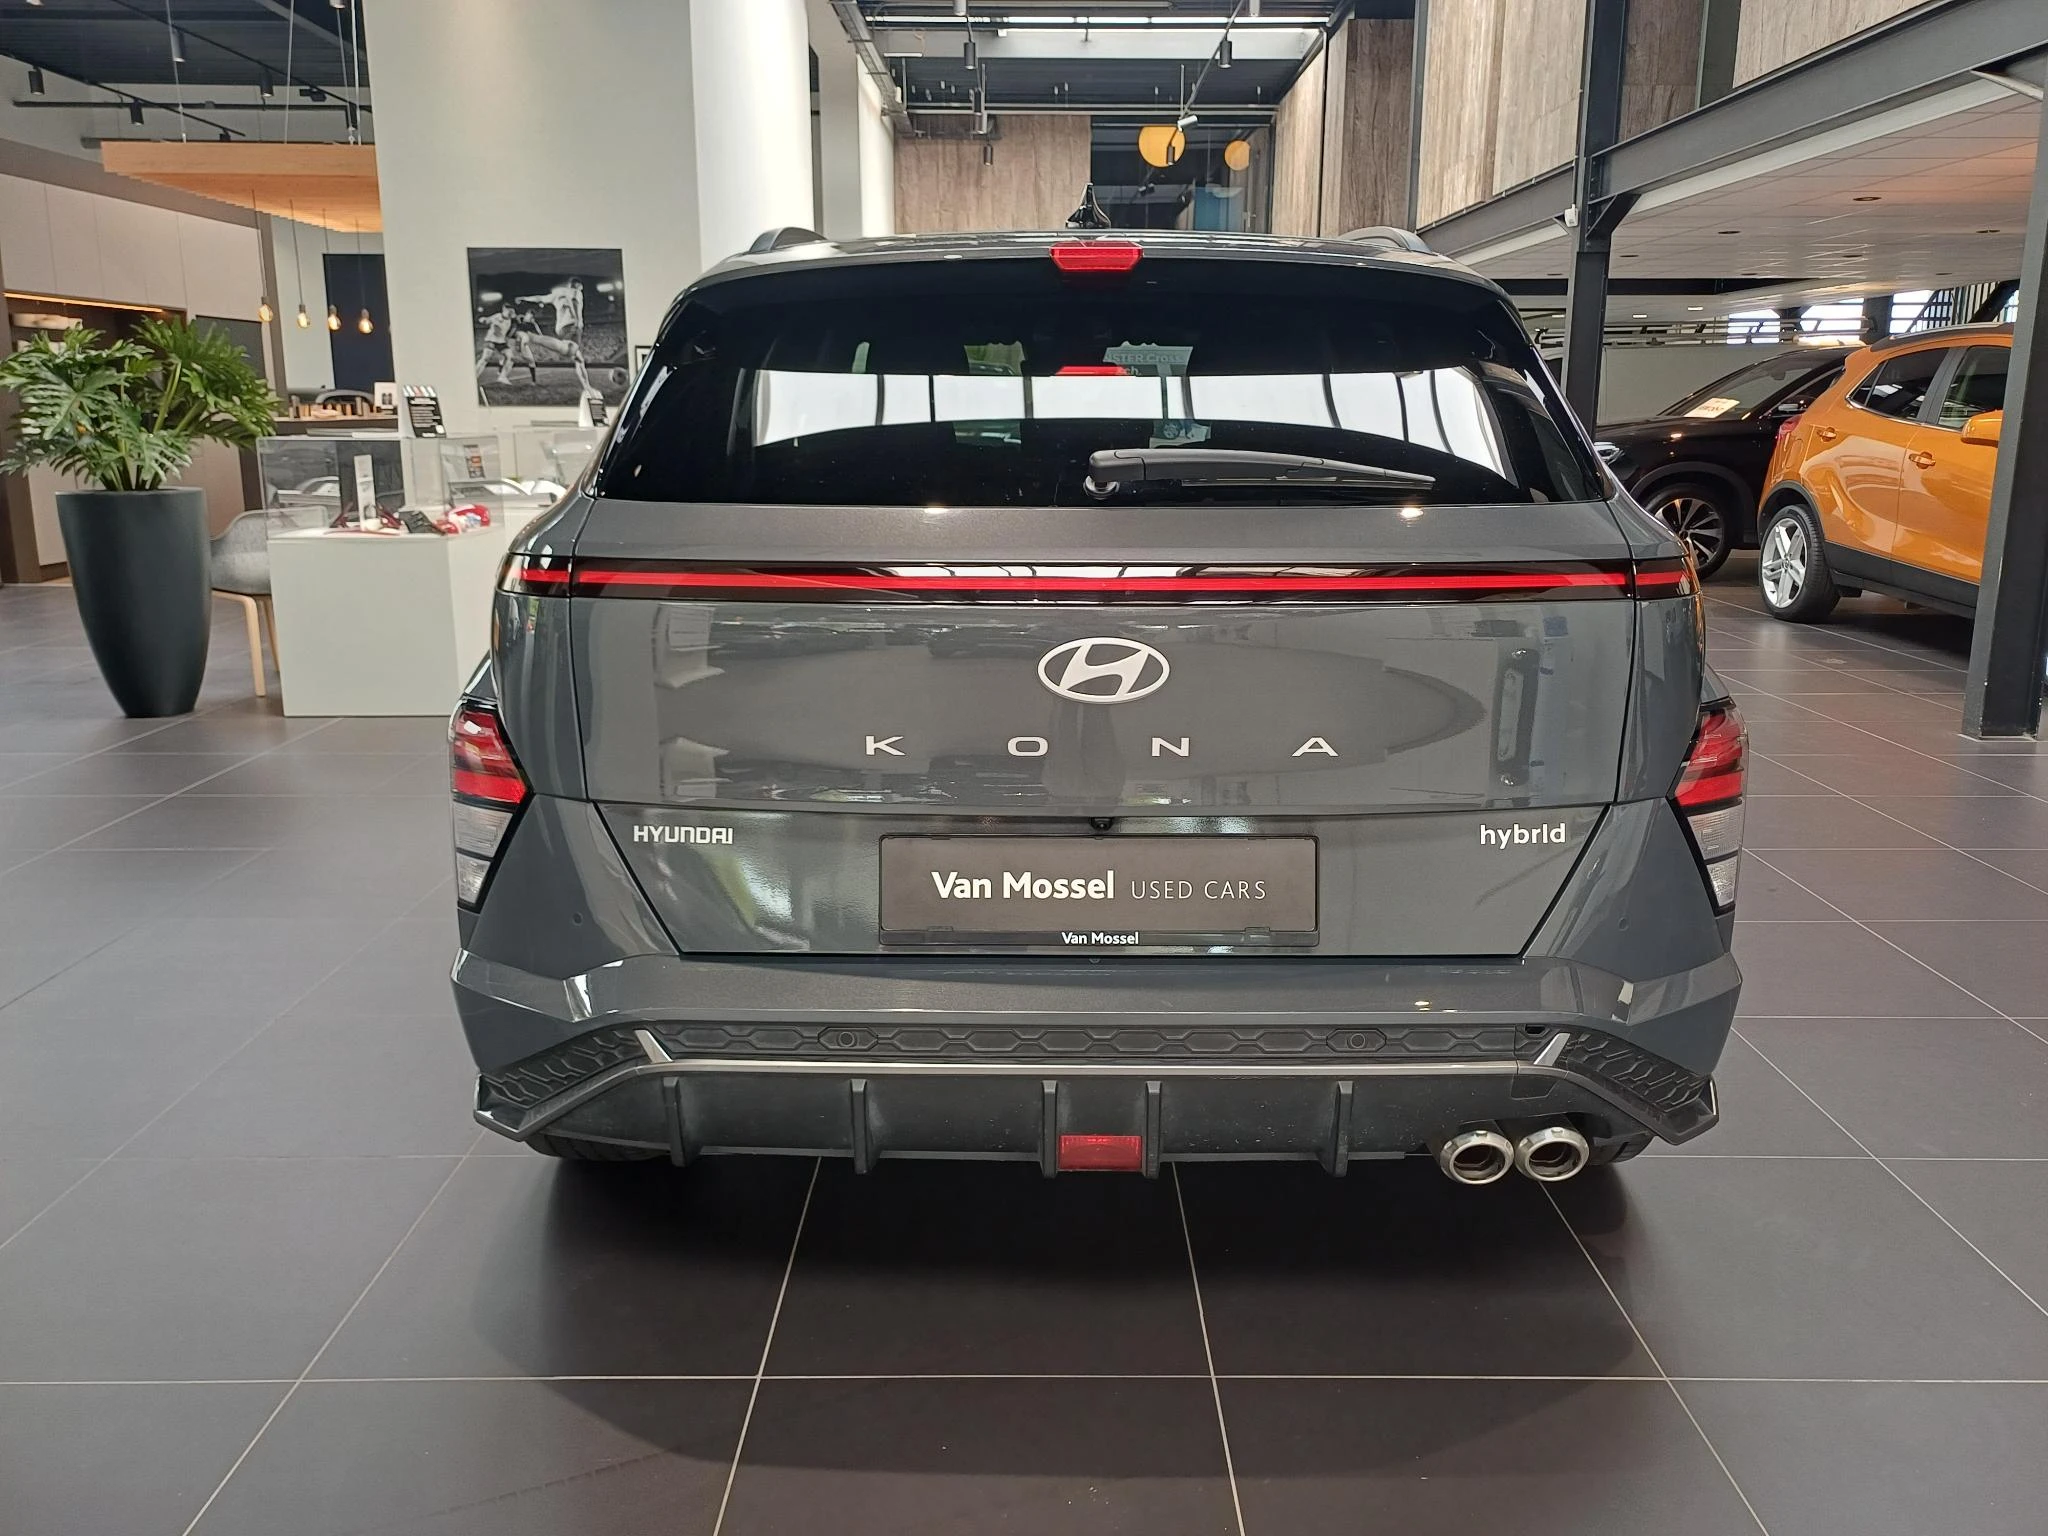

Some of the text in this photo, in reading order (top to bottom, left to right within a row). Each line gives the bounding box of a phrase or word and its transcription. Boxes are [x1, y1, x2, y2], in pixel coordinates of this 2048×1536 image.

[865, 735, 1339, 758] KONA
[633, 825, 734, 845] HYUNDAI
[1480, 822, 1566, 850] hybrid
[931, 870, 1267, 899] Van Mossel USED CARS
[1061, 931, 1139, 945] Van Mossel
